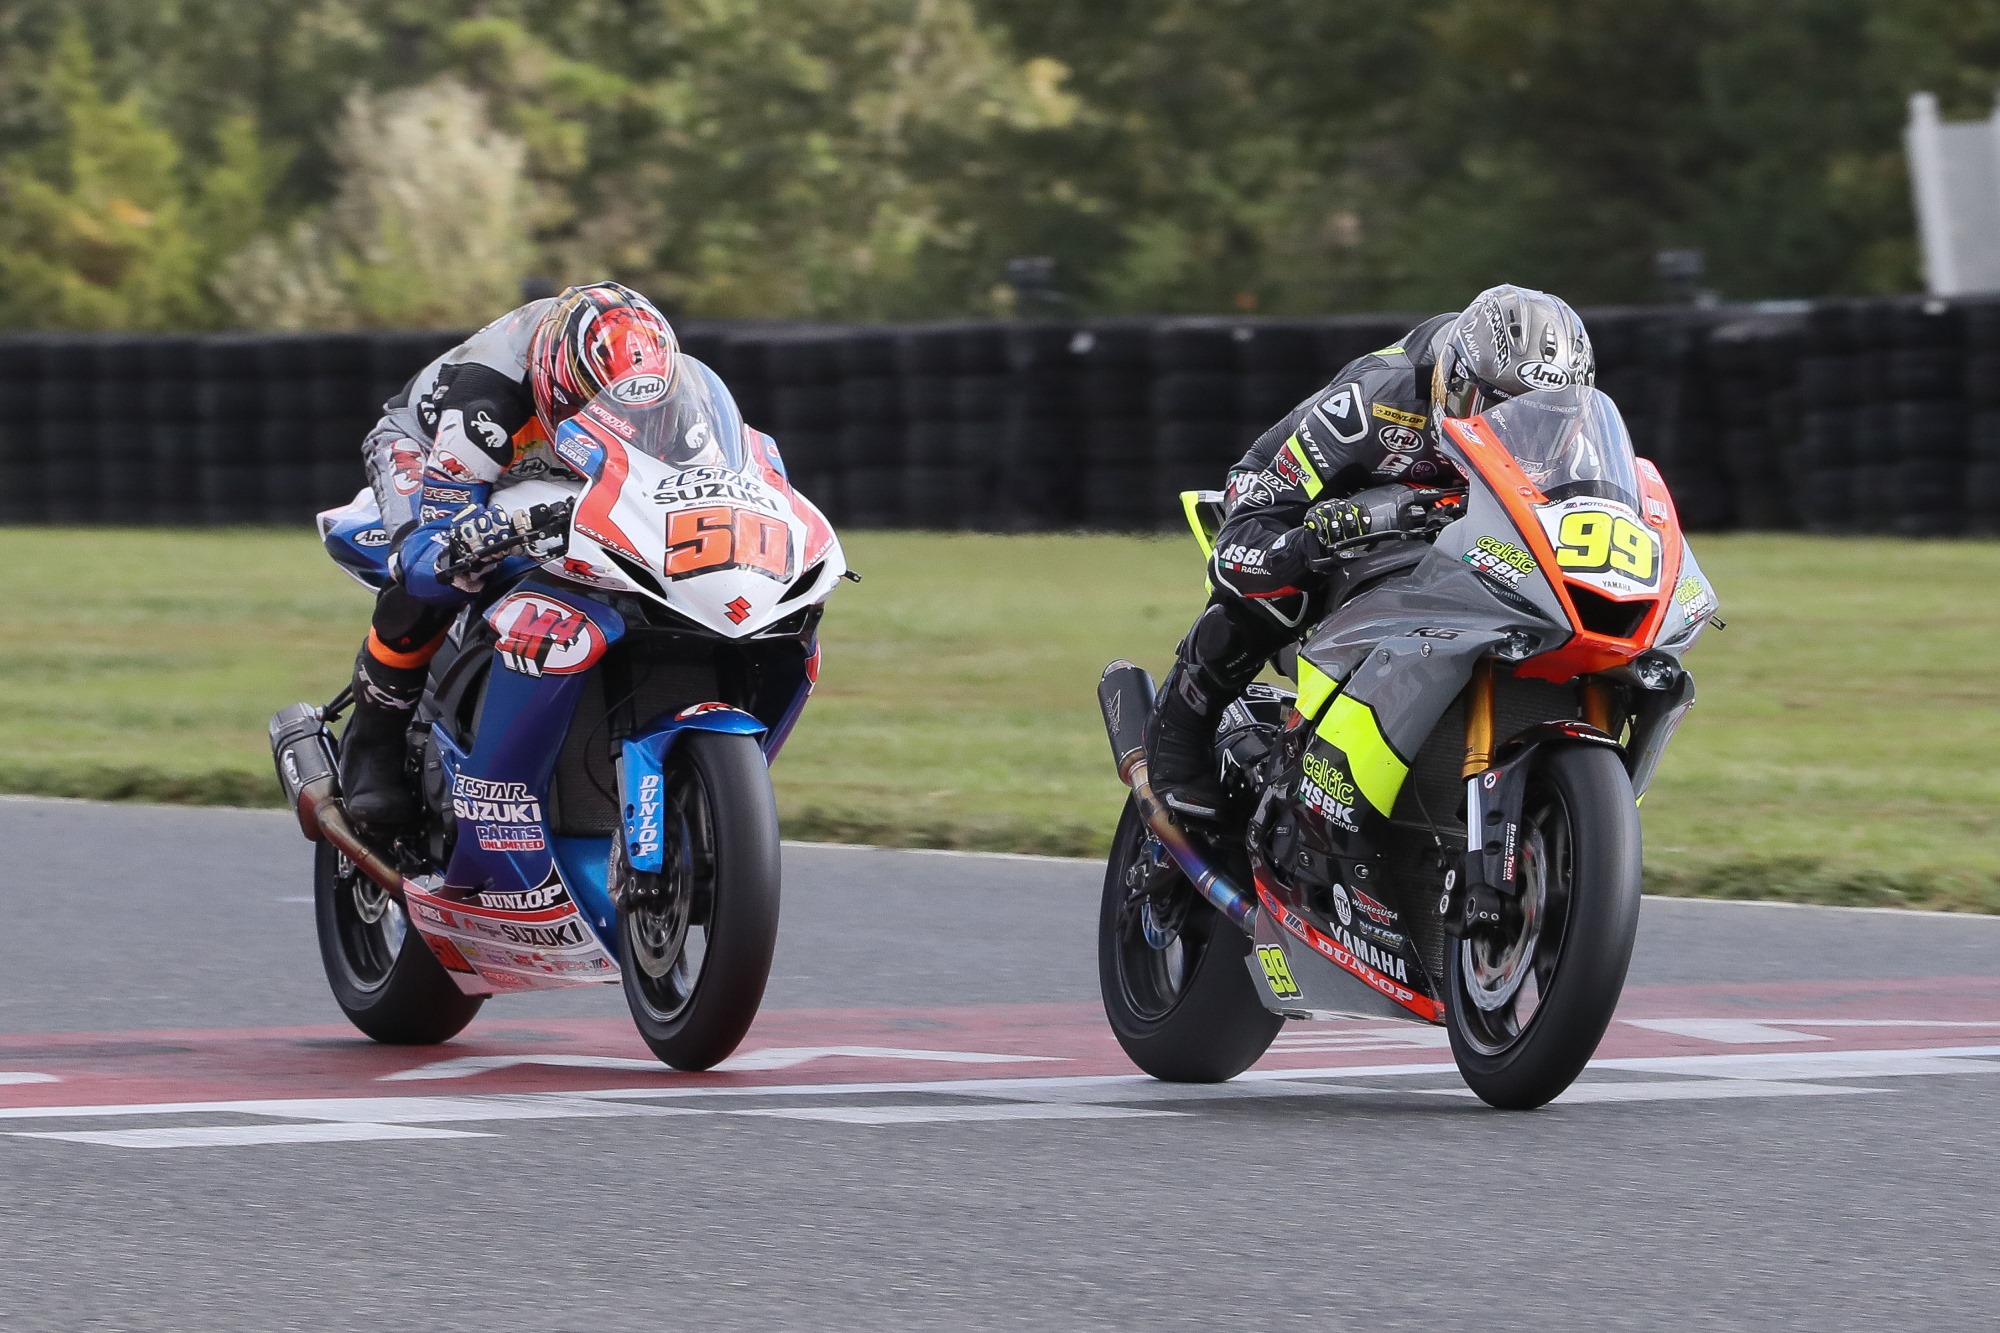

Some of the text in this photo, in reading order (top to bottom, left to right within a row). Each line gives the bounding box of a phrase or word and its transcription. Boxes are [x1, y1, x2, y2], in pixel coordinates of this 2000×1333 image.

[1462, 317, 1480, 362] Dawn
[616, 377, 662, 397] Arai
[1521, 365, 1564, 386] Arai
[1384, 410, 1423, 424] DUNLOP
[1383, 429, 1416, 446] Arai
[558, 444, 588, 467] SUZUKI
[423, 486, 471, 500] TCX
[654, 466, 762, 495] ECSTAR
[653, 483, 779, 511] SUZUKI
[357, 530, 387, 542] Ara
[664, 506, 795, 586] 50
[1475, 536, 1538, 574] celtic
[1556, 511, 1659, 588] 99
[1465, 547, 1529, 584] HSBK
[1486, 568, 1519, 590] RACING
[1602, 580, 1632, 593] YAMAHA
[1675, 576, 1704, 605] celtic
[1682, 593, 1710, 619] HSBK
[452, 774, 538, 801] ECSTAR
[1303, 752, 1355, 805] celtic
[453, 799, 542, 823] SUZUKI
[1300, 775, 1355, 824] HSBK
[638, 775, 659, 857] DUNLOP
[1320, 810, 1359, 833] RACING
[476, 826, 543, 841] PARTS
[480, 839, 545, 851] UNLIMITED
[479, 884, 563, 910] DUNLOP
[1352, 898, 1398, 920] WerkesUSA
[500, 921, 585, 947] SUZUKI
[1329, 921, 1408, 984] YAMAHA
[1256, 944, 1303, 1001] 99
[1317, 938, 1413, 1001] DUNLOP
